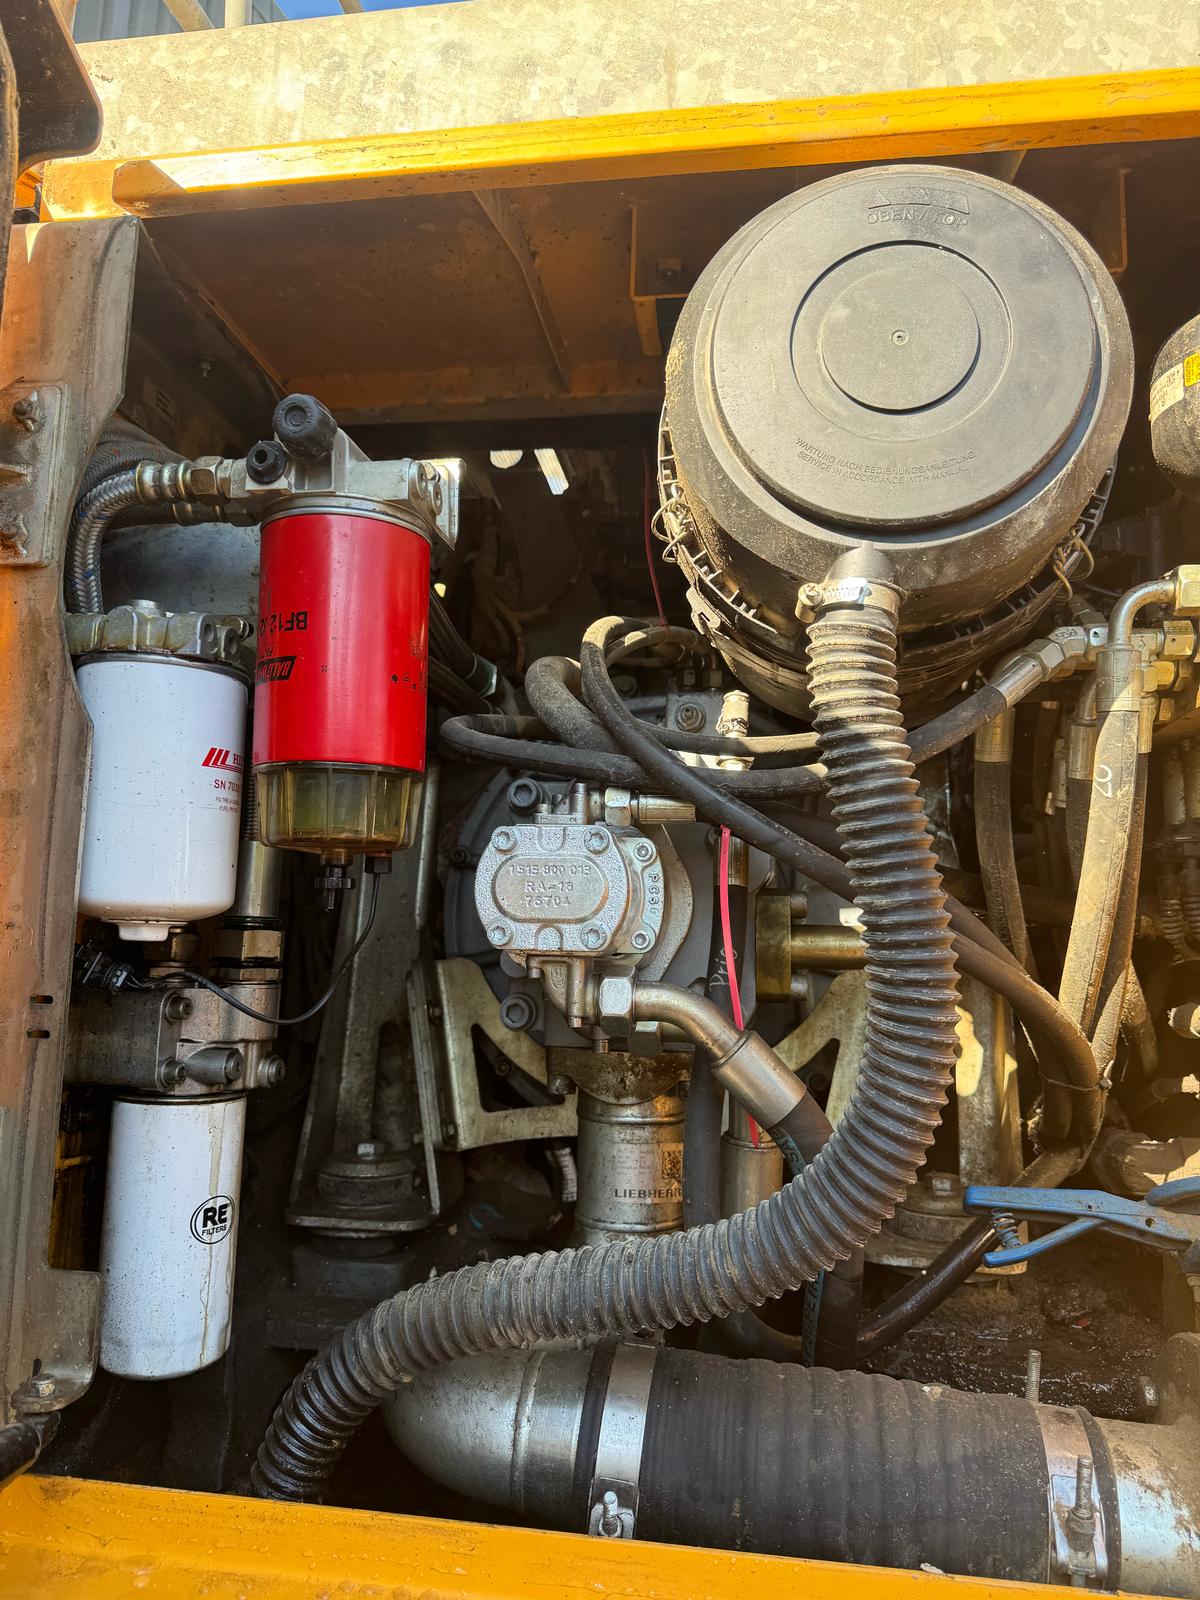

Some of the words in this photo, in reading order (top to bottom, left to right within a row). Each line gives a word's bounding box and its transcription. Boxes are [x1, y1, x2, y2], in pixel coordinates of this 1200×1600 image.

[796, 438, 836, 465] WARTUNG
[836, 457, 863, 472] NACH
[864, 451, 976, 476] BEDIENUNGSANLEITUNG
[797, 451, 832, 473] SERVICE
[841, 470, 904, 485] ACCORDANCE
[907, 473, 929, 484] WITH
[931, 465, 969, 481] MANUAL
[213, 778, 227, 790] SN
[614, 1188, 681, 1199] LIEBHERR
[202, 1202, 231, 1229] RE
[201, 1224, 228, 1237] FILTERS
